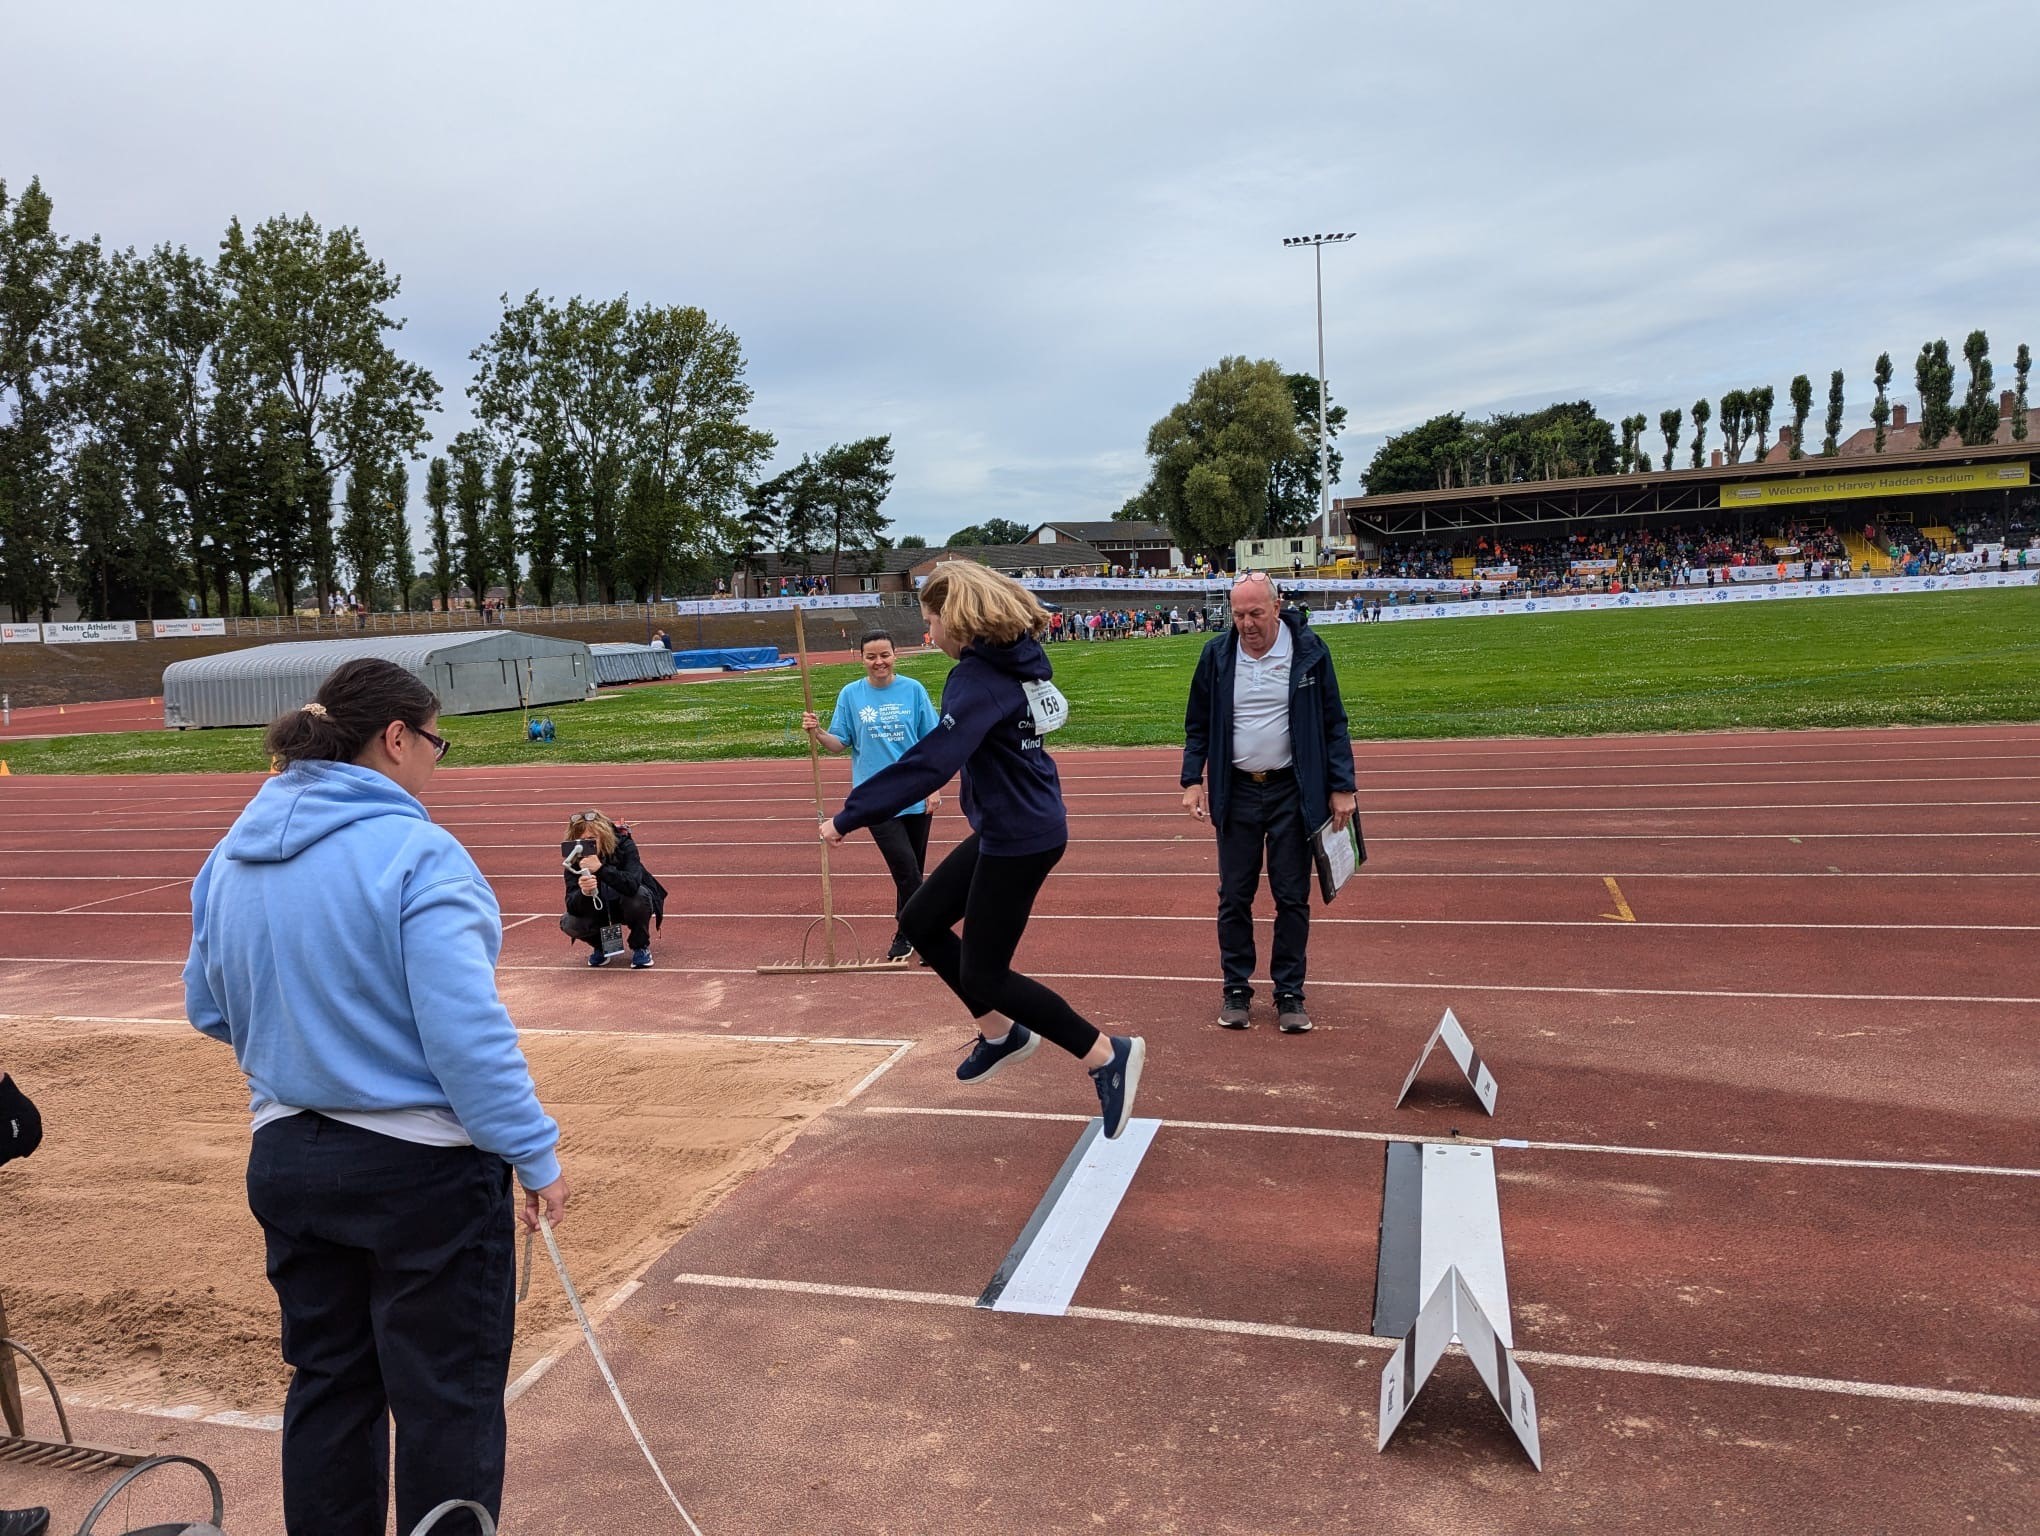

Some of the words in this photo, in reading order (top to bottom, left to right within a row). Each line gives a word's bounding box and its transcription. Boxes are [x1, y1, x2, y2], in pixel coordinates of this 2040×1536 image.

[1768, 486, 1820, 497] Welcome
[1823, 484, 1834, 492] to
[1837, 480, 1876, 492] Harvey
[1879, 475, 1923, 488] Hadden
[1926, 472, 1975, 484] Stadium
[61, 624, 84, 632] Notts
[87, 623, 117, 631] Athletic
[82, 631, 100, 639] Club
[1040, 695, 1060, 717] 158
[1021, 737, 1041, 750] Kind
